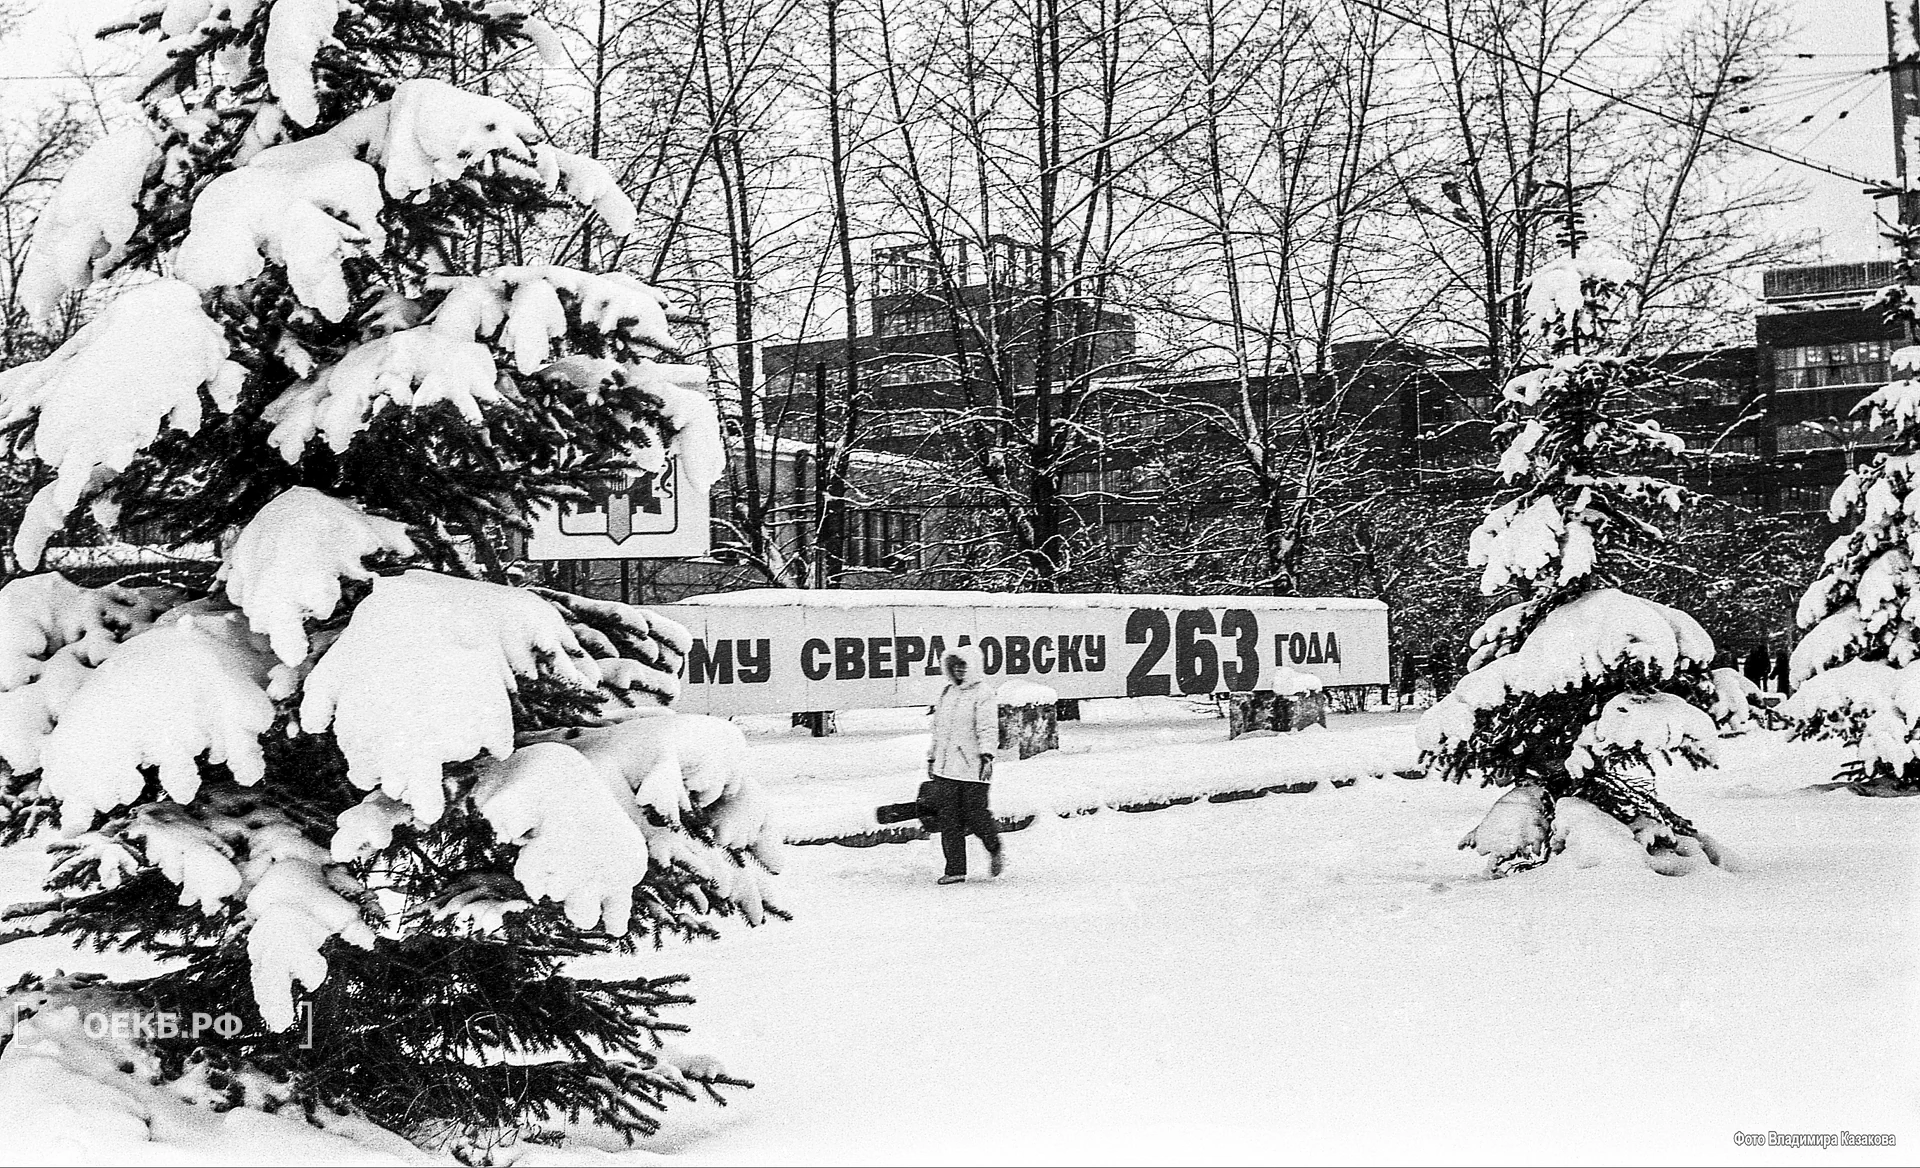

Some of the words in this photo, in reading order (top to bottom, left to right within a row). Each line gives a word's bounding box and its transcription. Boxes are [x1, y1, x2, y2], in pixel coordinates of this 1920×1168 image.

[677, 638, 771, 684] МУ
[801, 634, 1106, 681] СВЕРДОВСКУ
[1125, 608, 1260, 697] 263
[1274, 632, 1341, 667] ГОДА
